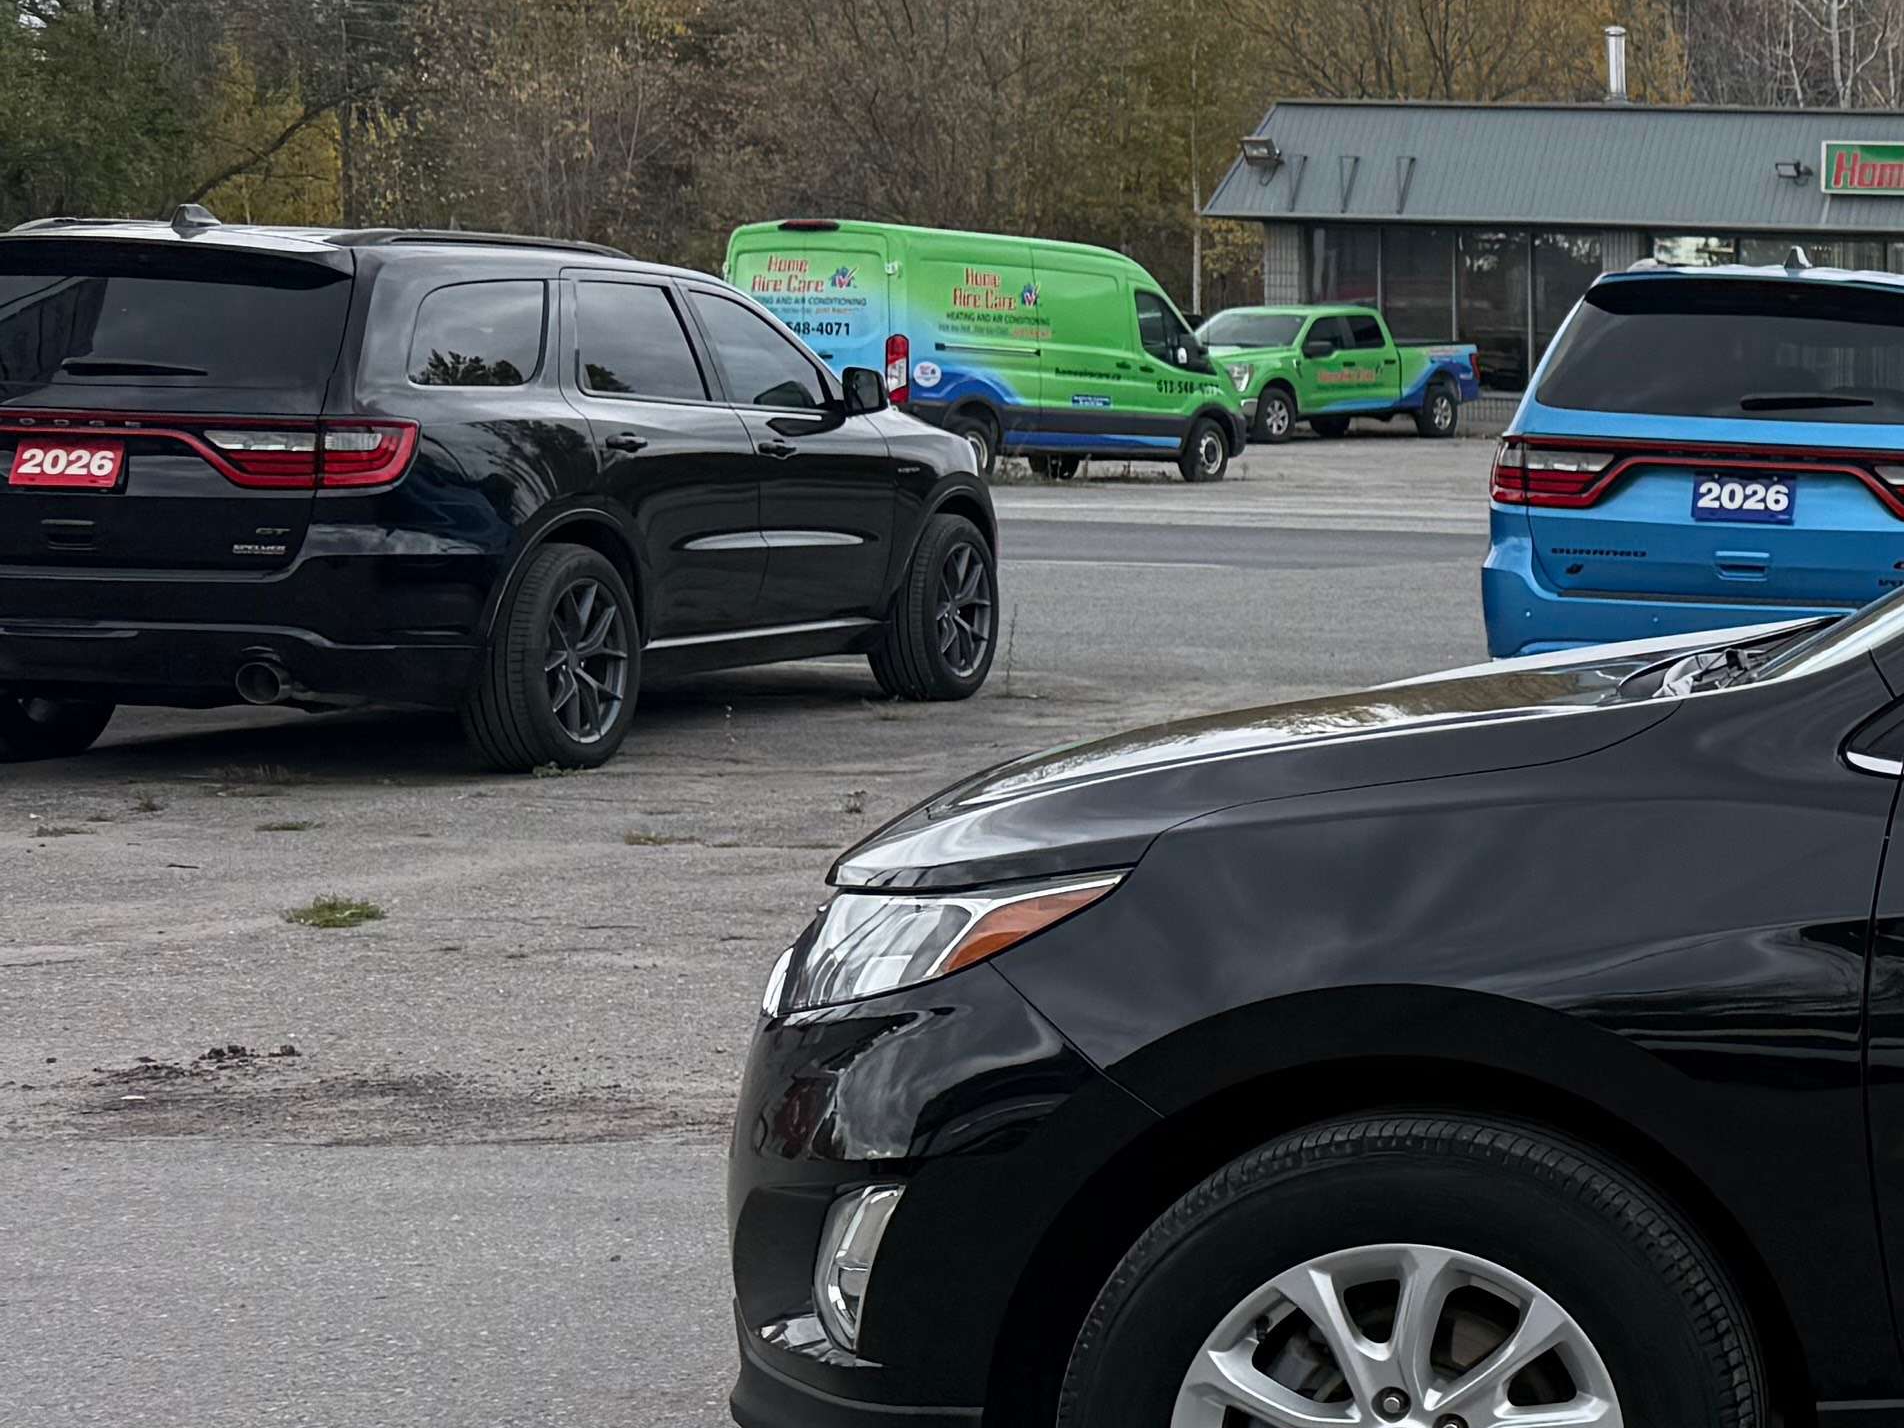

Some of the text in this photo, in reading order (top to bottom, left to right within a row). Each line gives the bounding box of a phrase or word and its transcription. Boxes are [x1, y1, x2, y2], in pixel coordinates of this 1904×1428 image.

[767, 255, 809, 274] Home
[751, 273, 825, 293] Aire Care
[964, 267, 1001, 288] Home
[16, 448, 115, 477] 2026
[1697, 481, 1790, 512] 2026
